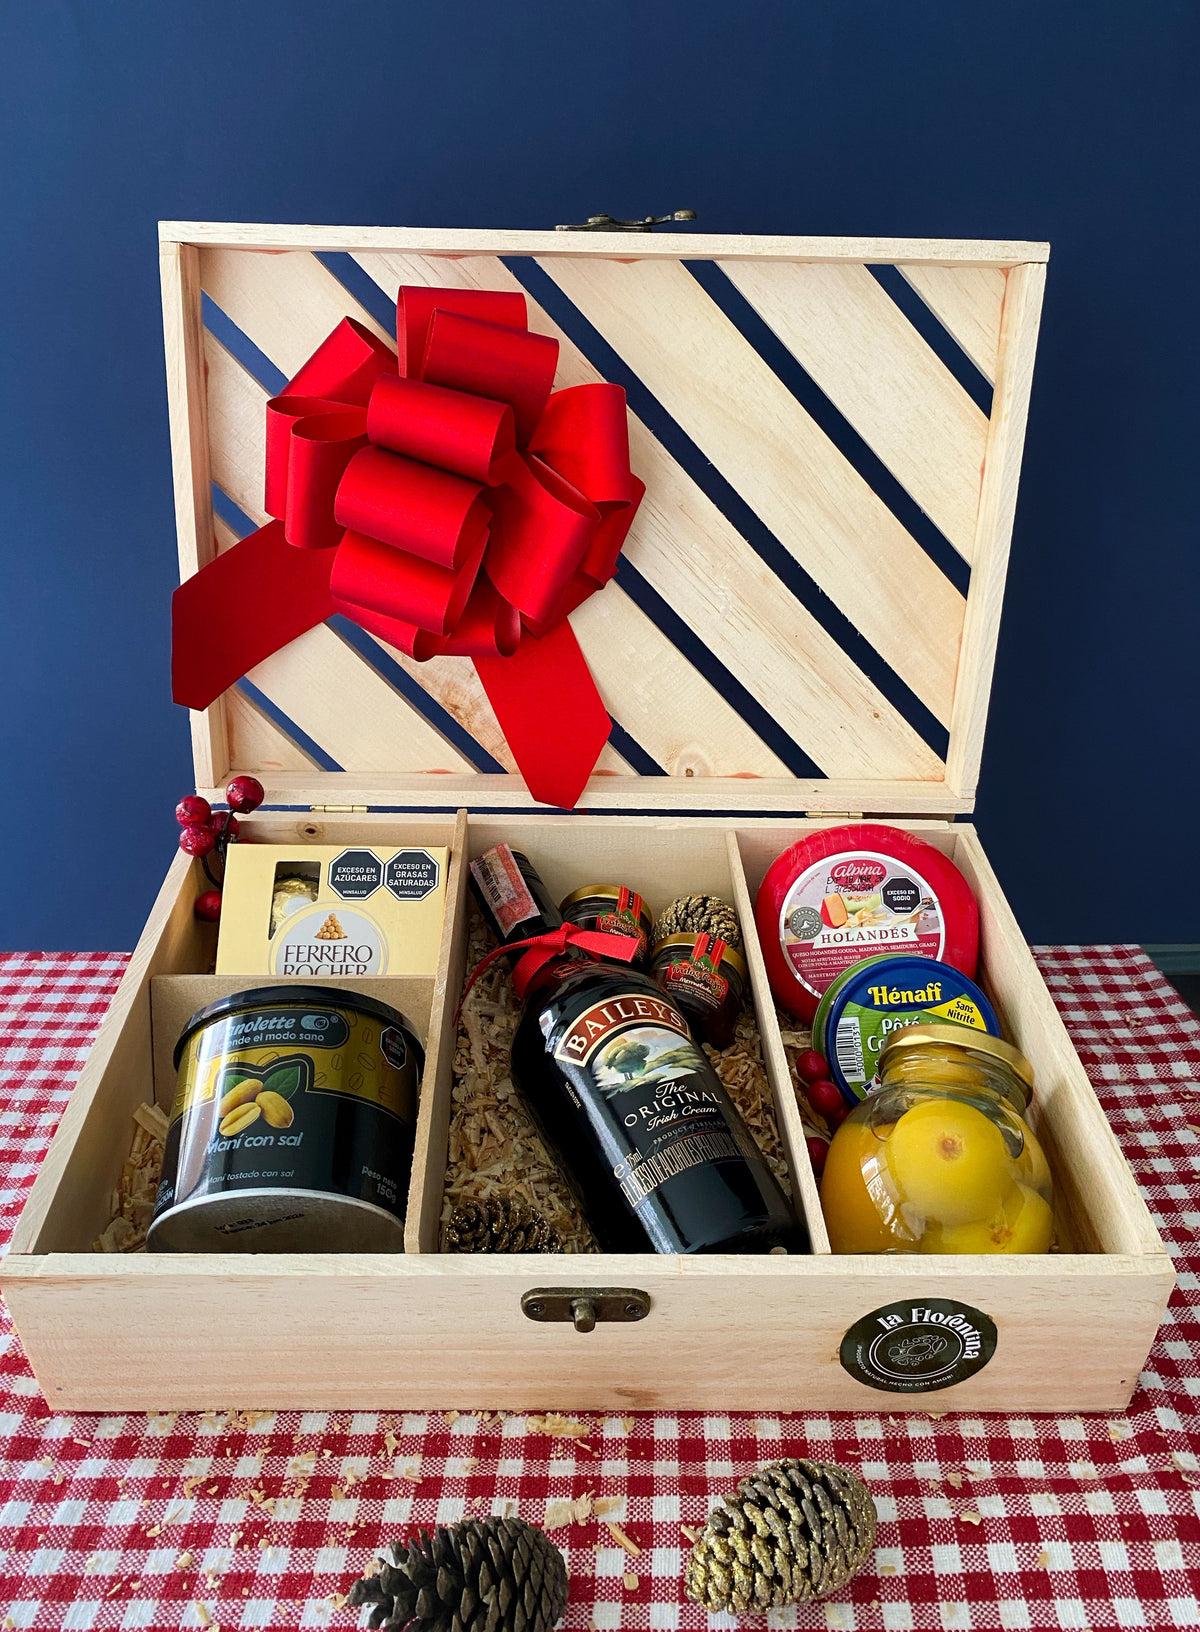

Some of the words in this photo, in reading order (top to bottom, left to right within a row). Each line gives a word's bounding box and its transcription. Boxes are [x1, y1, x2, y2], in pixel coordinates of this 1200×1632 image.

[334, 872, 377, 882] AZÚCARES
[388, 879, 434, 887] SATURADAS
[821, 927, 909, 944] HOLANDÉS
[284, 944, 373, 963] FERRERO
[792, 951, 810, 959] QUESO
[867, 981, 942, 1006] Hénaff
[946, 1008, 976, 1025] Nitrite
[955, 1000, 974, 1014] Sans
[253, 1032, 263, 1042] el
[265, 1031, 297, 1041] modo
[299, 1032, 325, 1042] sano
[566, 1000, 682, 1055] BAILEYS
[853, 1026, 862, 1048] 0131
[655, 1081, 688, 1099] The
[624, 1091, 723, 1127] ORIGINAL
[646, 1109, 680, 1132] Irish
[682, 1105, 718, 1117] Cream
[207, 1133, 244, 1154] Maní
[244, 1135, 274, 1148] con
[277, 1131, 304, 1147] sal
[227, 1170, 260, 1181] tostado
[261, 1170, 278, 1178] con
[280, 1169, 295, 1177] sal
[361, 1165, 381, 1180] Peso
[382, 1176, 398, 1190] neto
[376, 1182, 397, 1204] 150g
[911, 1307, 983, 1360] Florentina
